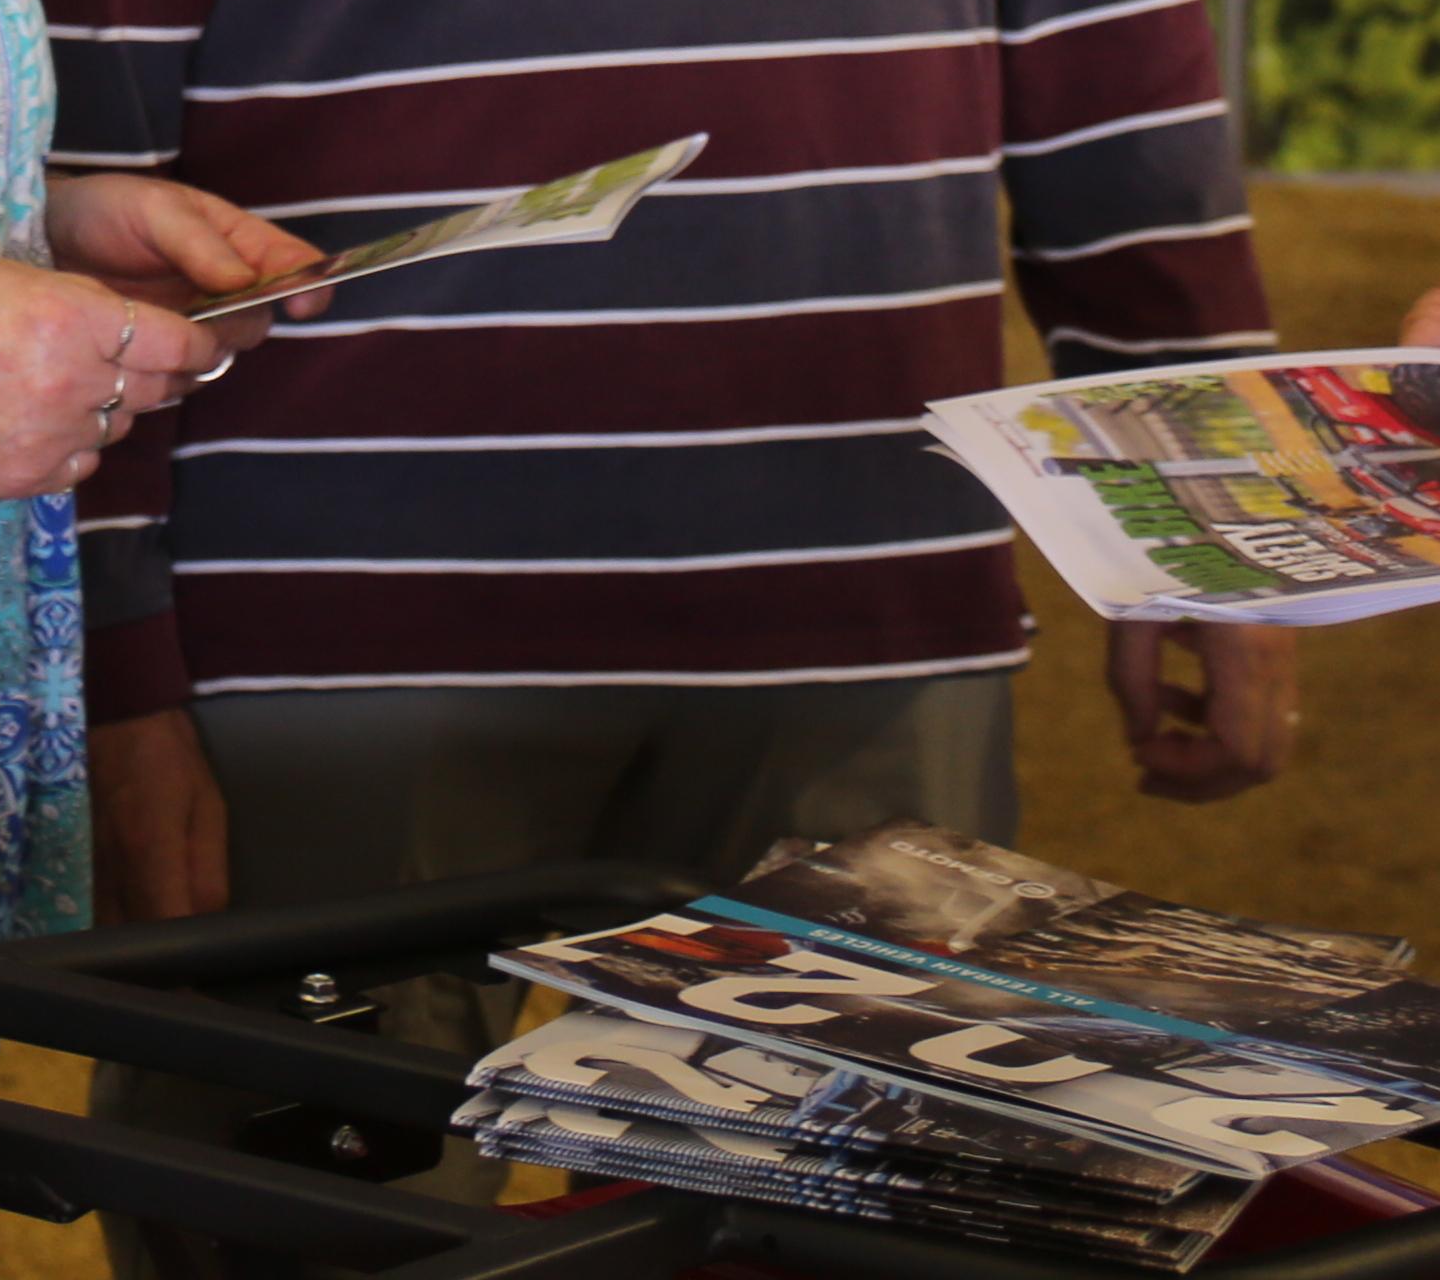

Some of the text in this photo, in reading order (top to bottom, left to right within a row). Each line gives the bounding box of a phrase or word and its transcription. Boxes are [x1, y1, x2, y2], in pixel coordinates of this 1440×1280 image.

[1208, 522, 1377, 583] SAFETY
[808, 928, 1095, 1007] ALL TERRAIN VEHICLES
